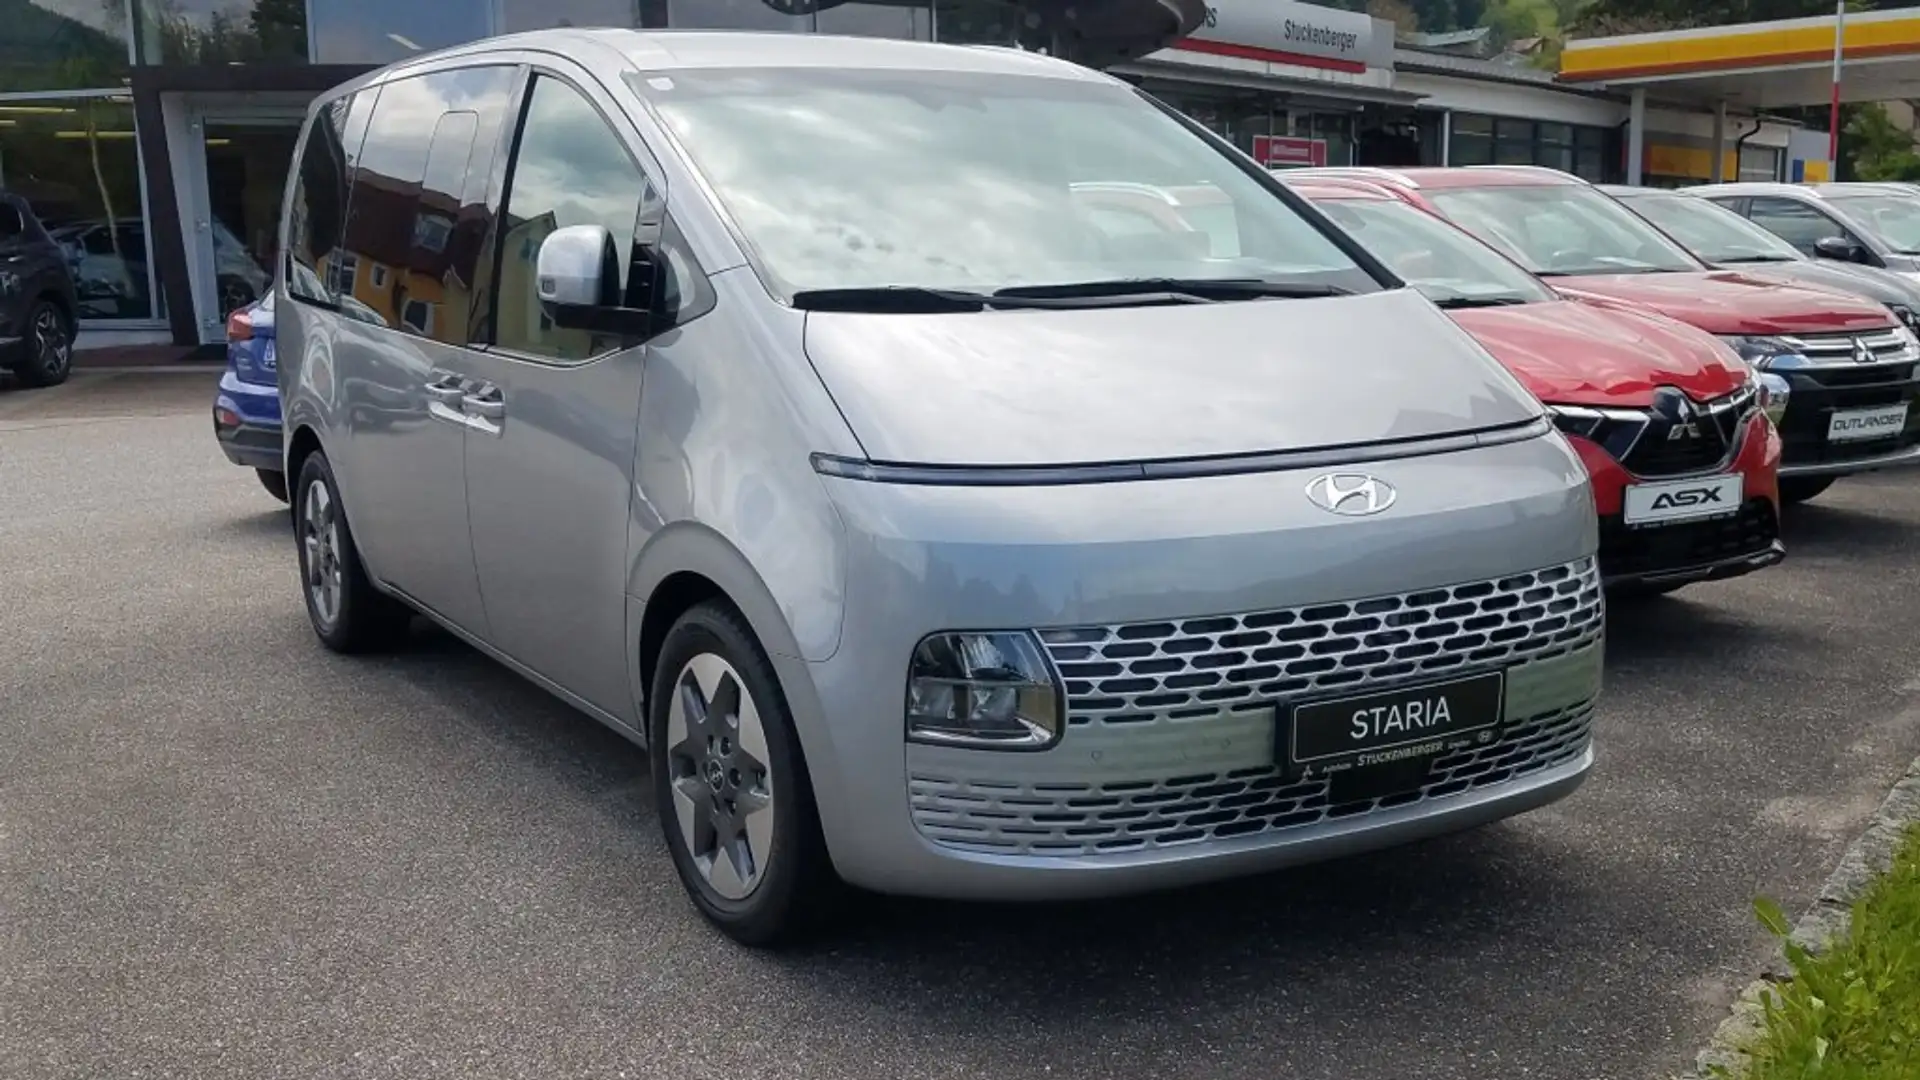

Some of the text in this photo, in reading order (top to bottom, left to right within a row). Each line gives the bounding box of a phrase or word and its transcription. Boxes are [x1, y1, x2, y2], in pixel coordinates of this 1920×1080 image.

[1284, 19, 1357, 52] Stuckenberger
[1833, 412, 1904, 431] OUTLANDER
[1651, 486, 1722, 510] ASX
[1350, 696, 1451, 739] STARIA
[1357, 741, 1444, 767] STUCKENBERGER
